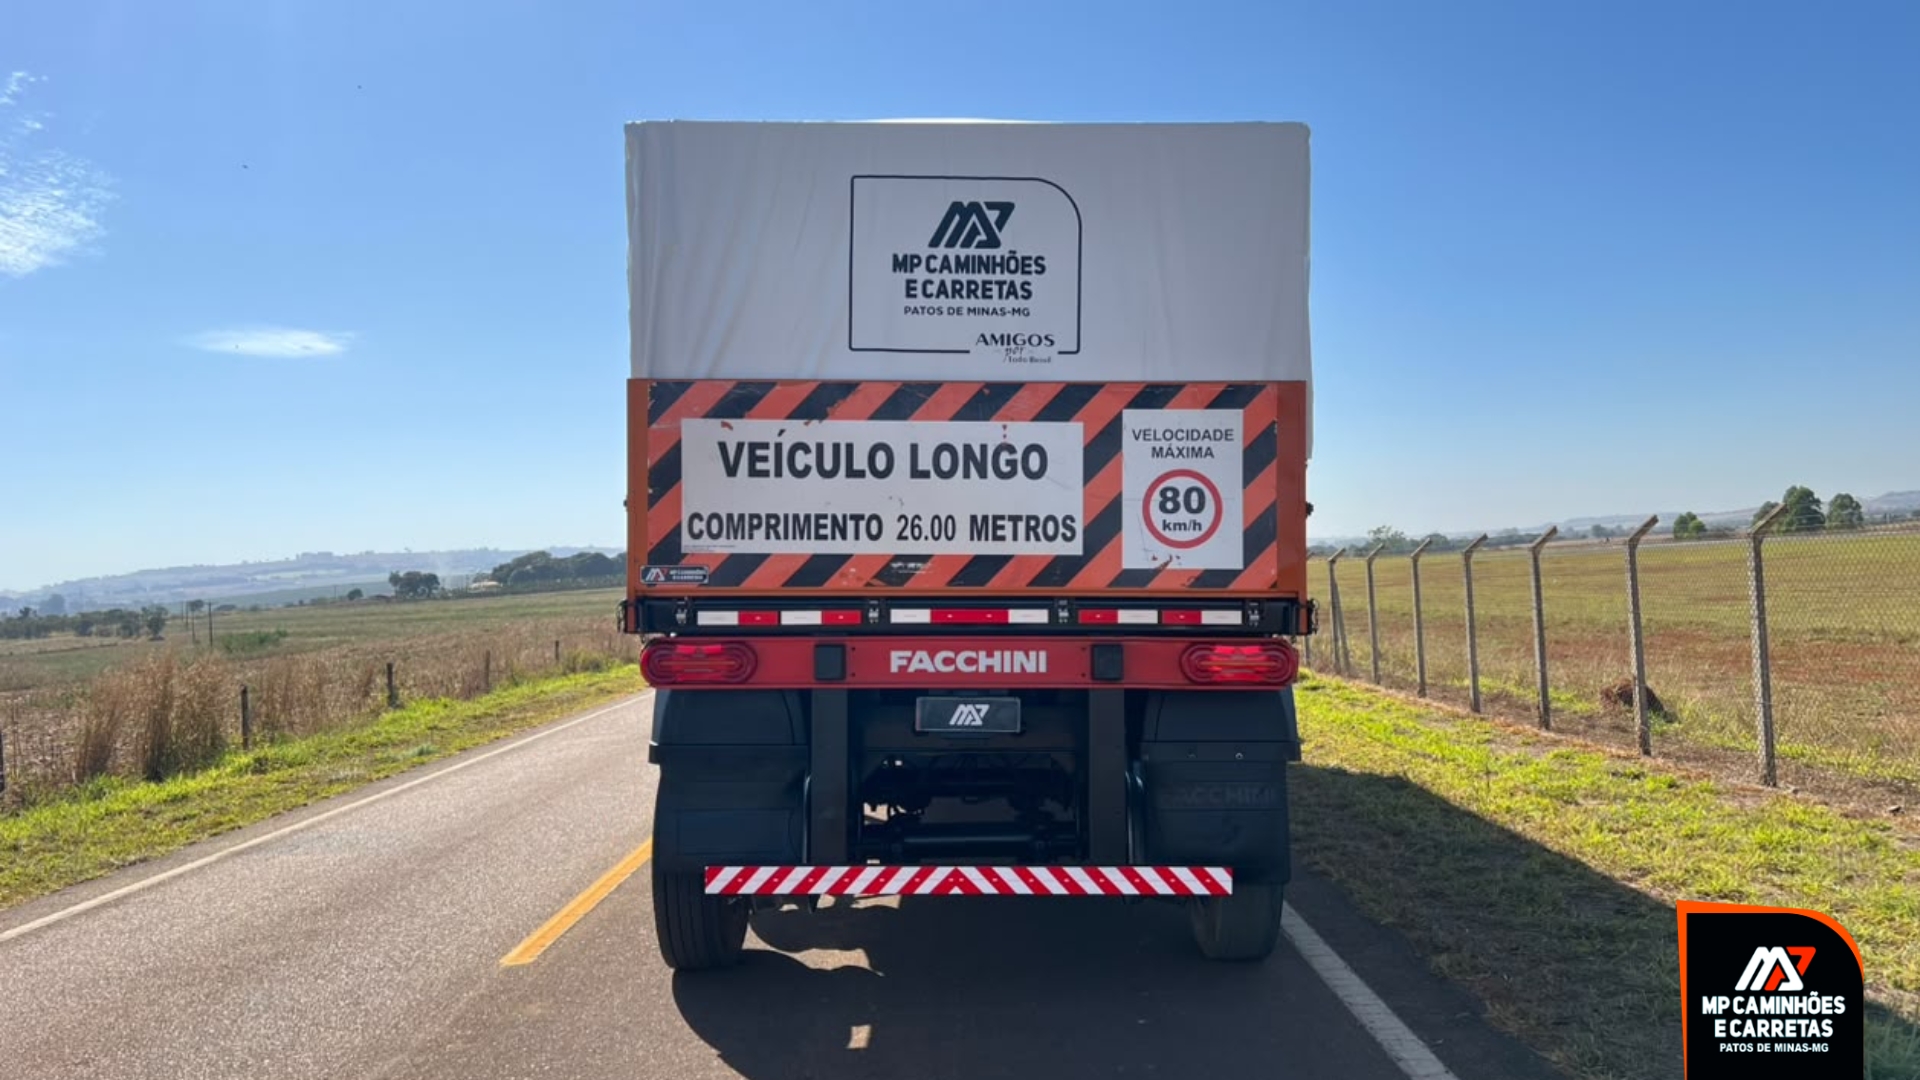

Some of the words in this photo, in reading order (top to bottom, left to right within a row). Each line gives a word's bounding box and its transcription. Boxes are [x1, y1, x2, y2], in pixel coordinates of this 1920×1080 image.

[892, 253, 923, 274] MP
[925, 250, 1047, 276] CAMINHÕES
[905, 278, 918, 299] E
[921, 279, 1033, 301] CARRETAS
[903, 305, 944, 316] PATOS
[946, 306, 963, 316] DE
[966, 306, 1031, 317] MINAS-MG
[975, 332, 1055, 347] AMIGOS
[1131, 428, 1235, 442] VELOCIDADE
[717, 429, 895, 480] VEÍCULO
[909, 442, 1048, 481] LONGO
[1151, 443, 1215, 459] MÁXIMA
[1158, 486, 1206, 514] 80
[687, 511, 884, 542] COMPRIMENTO
[896, 514, 957, 542] 26.00
[969, 514, 1077, 543] METROS
[1162, 518, 1203, 532] km/h
[890, 650, 1047, 673] FACCHINI
[1160, 787, 1277, 805] ACCHINI
